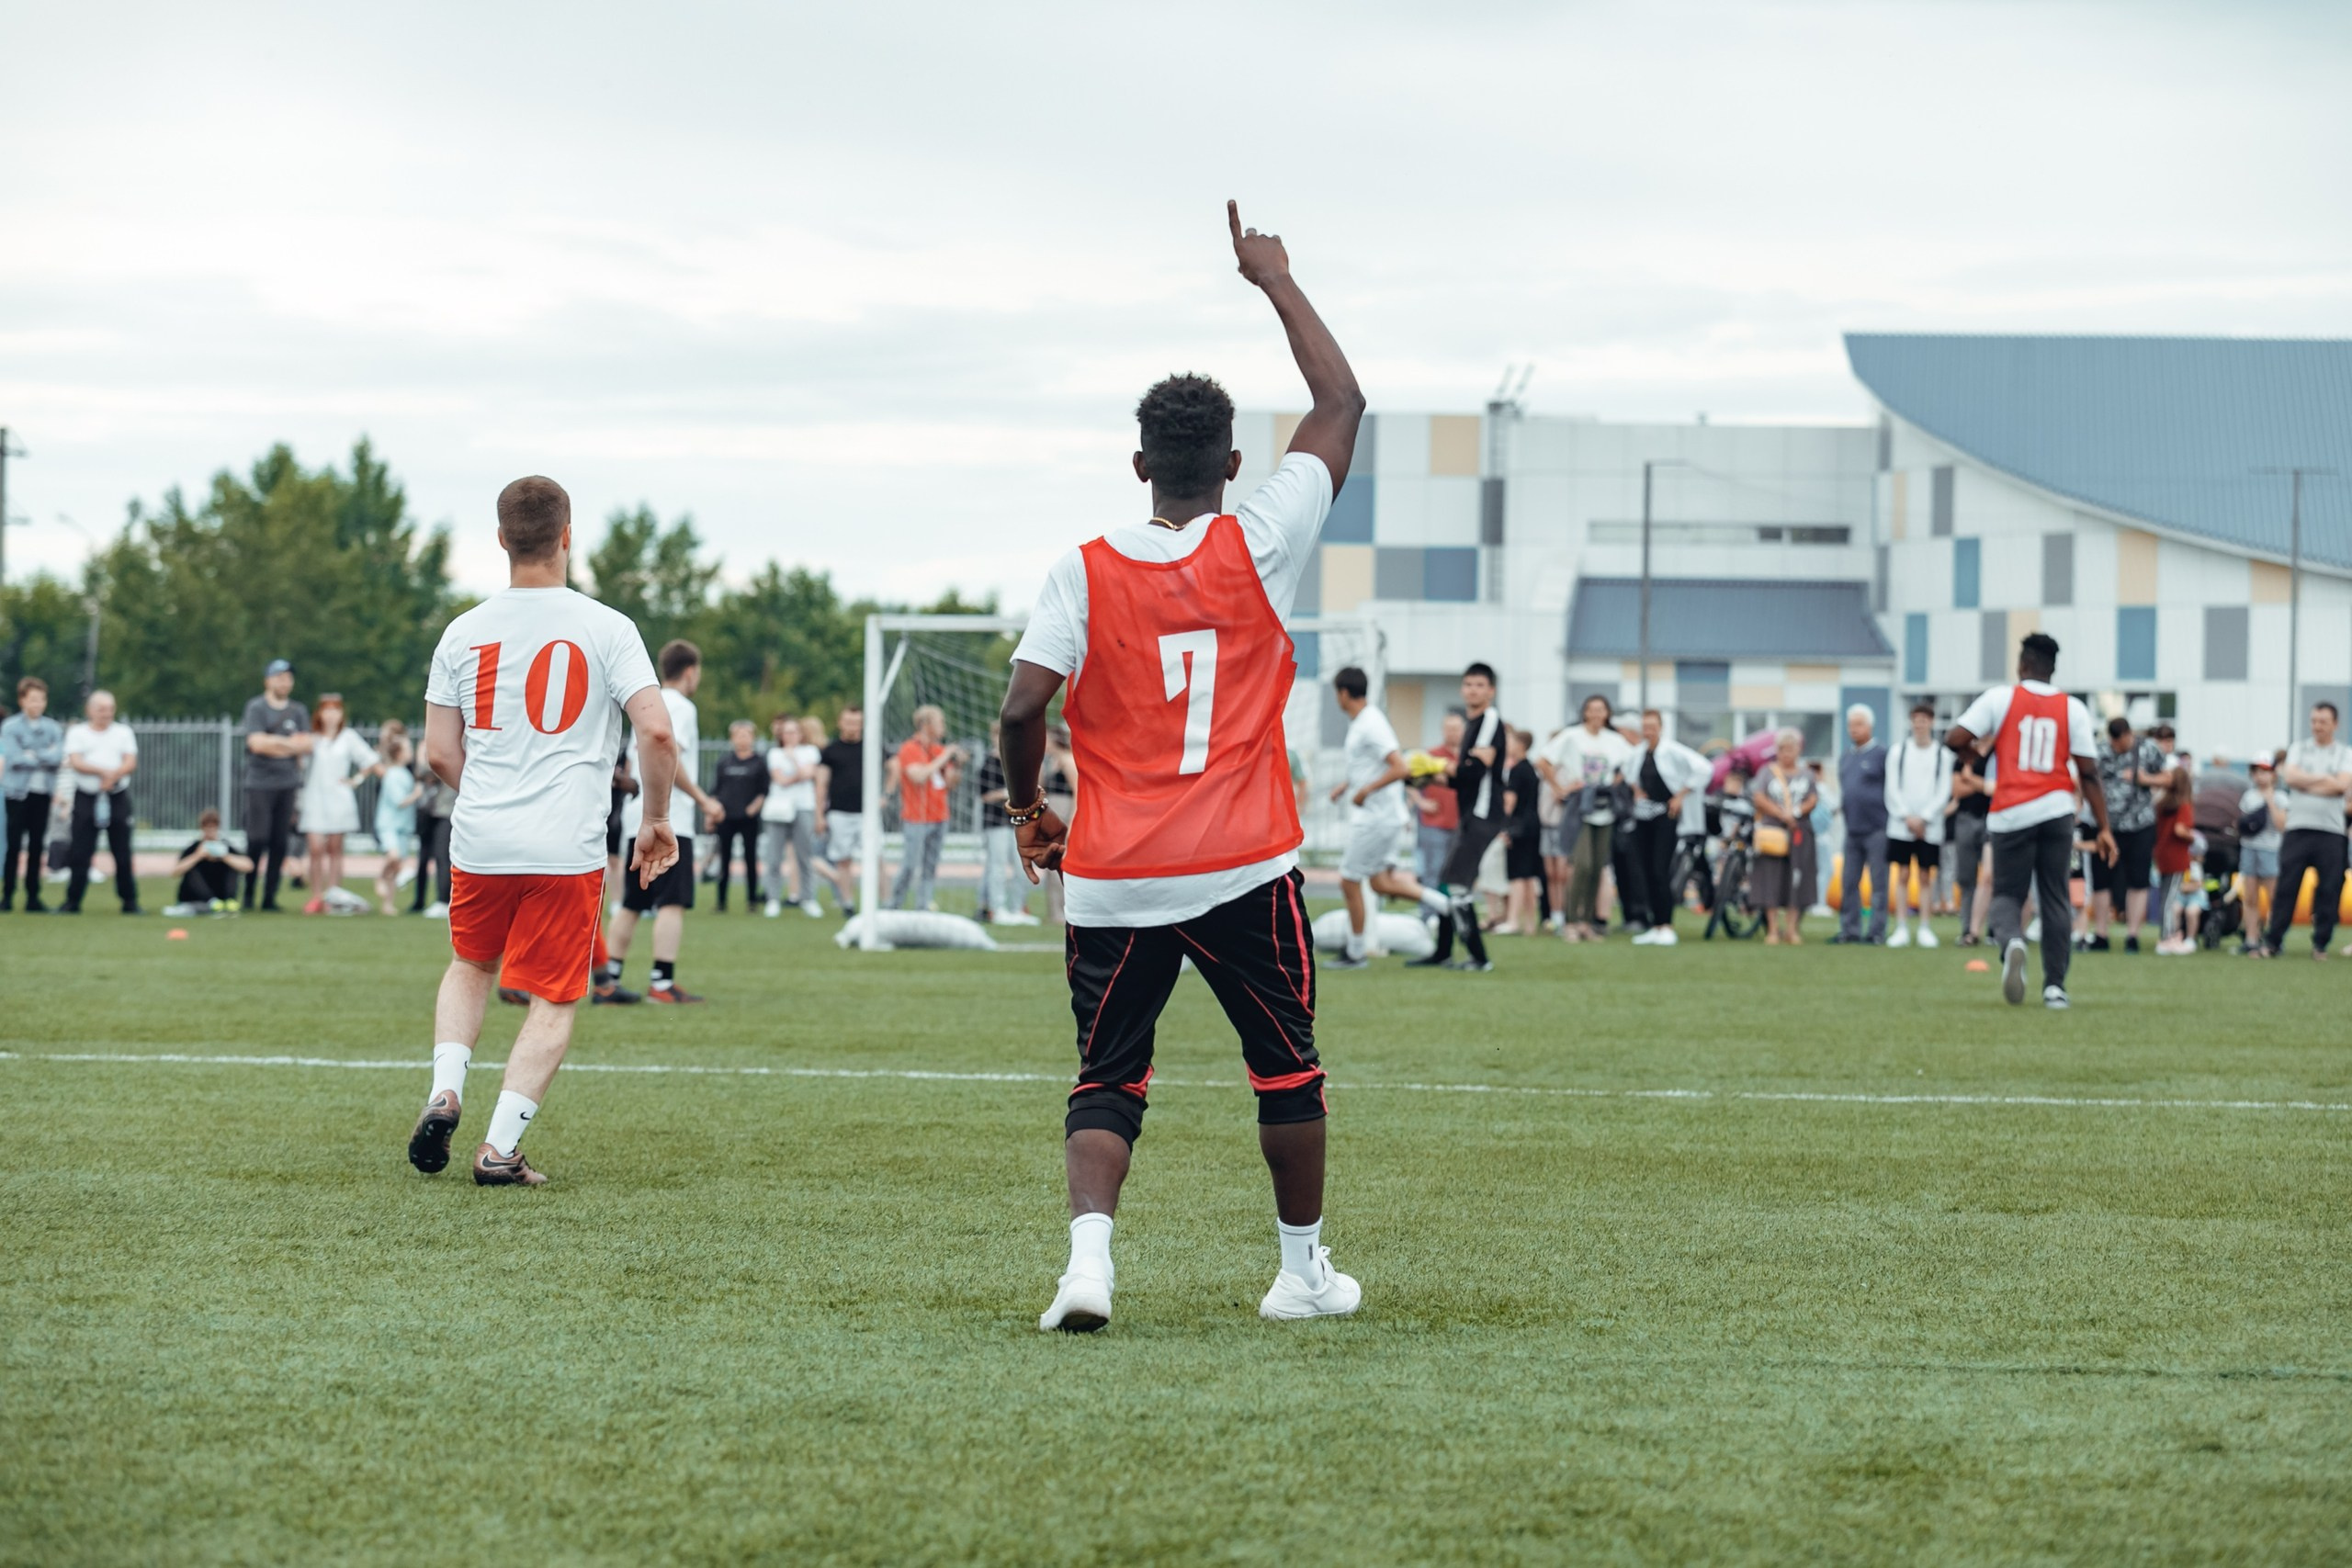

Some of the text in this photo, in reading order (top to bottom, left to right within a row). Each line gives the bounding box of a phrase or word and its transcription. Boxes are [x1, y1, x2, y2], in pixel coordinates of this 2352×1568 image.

[468, 639, 589, 735] 10
[1158, 628, 1218, 775] 7
[2018, 714, 2058, 773] 10
